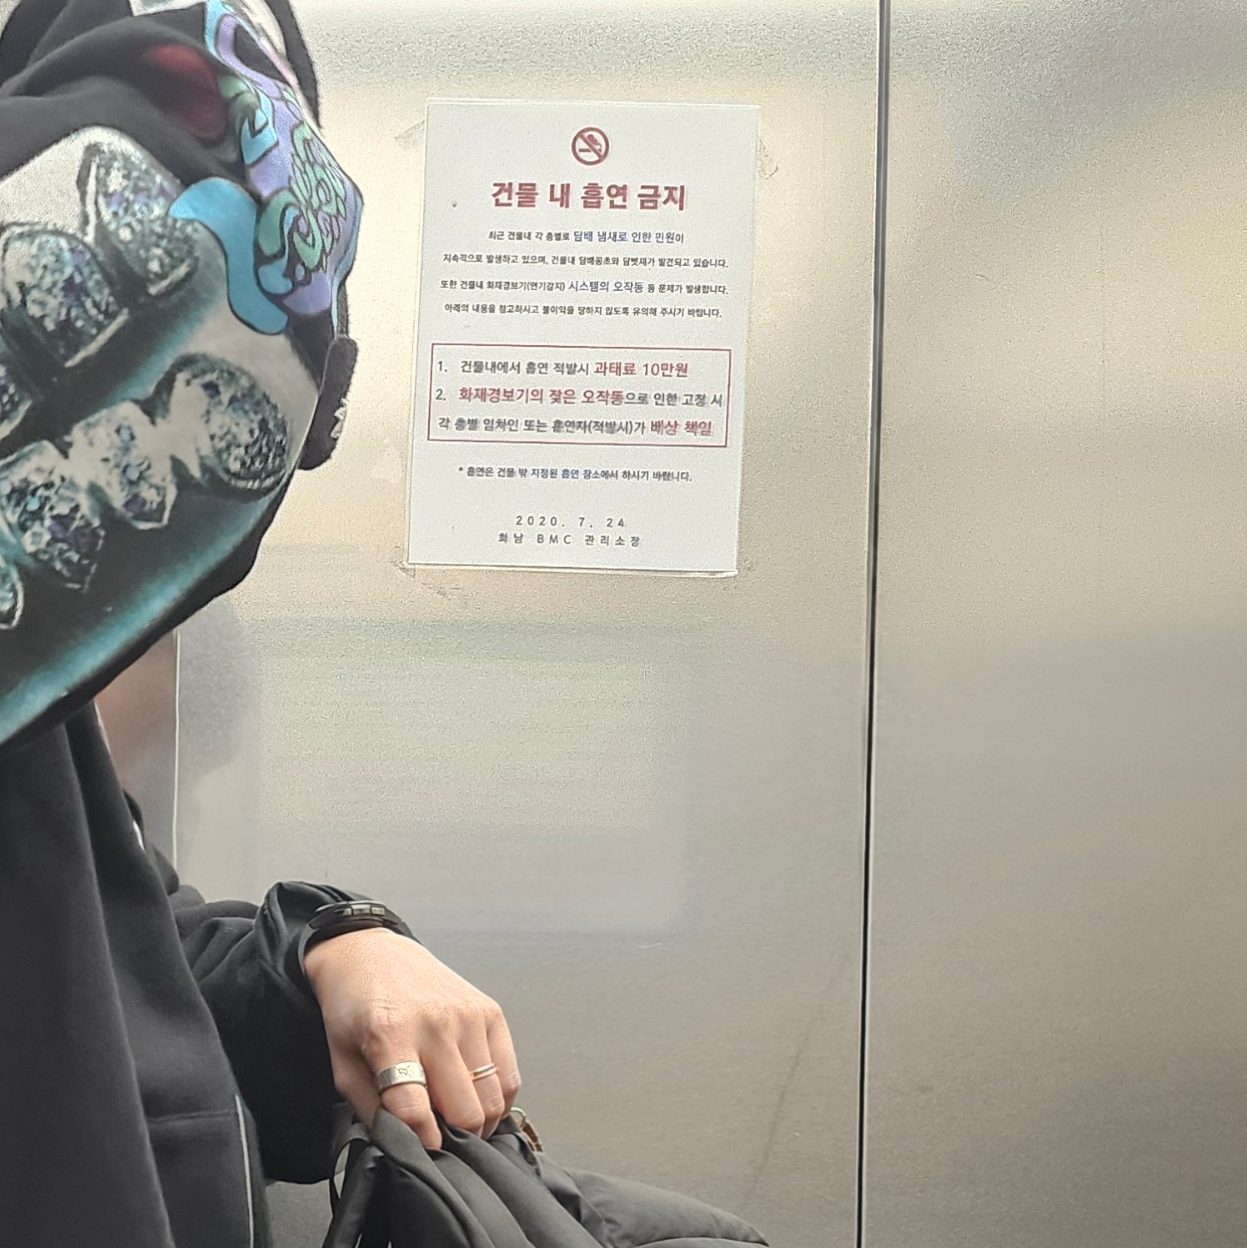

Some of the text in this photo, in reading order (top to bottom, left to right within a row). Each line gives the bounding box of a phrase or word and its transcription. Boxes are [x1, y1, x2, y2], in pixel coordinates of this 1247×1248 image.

[491, 182, 686, 211] 건물 내 흡연 금지
[488, 231, 504, 240] 최근
[507, 231, 532, 241] 건물내
[535, 232, 543, 241] 각
[573, 231, 593, 242] 담배
[597, 232, 627, 243] 냄새로
[631, 232, 652, 243] 인한
[655, 233, 684, 244] 민원이
[443, 254, 482, 263] 지속적으로
[486, 254, 519, 264] 발생하고
[551, 256, 575, 265] 건물내
[658, 258, 690, 267] 발견되고
[693, 258, 729, 268] 있습니다.
[440, 280, 457, 289] 또한
[460, 280, 484, 290] 건물내
[568, 281, 609, 292] 시스템의
[613, 282, 644, 294] 오작동
[658, 284, 683, 294] 문제가
[686, 284, 729, 295] 발생합니다.
[444, 304, 469, 313] 아래의
[472, 304, 495, 314] 내용을
[577, 306, 602, 315] 당하지
[633, 307, 657, 317] 유의해
[660, 307, 685, 317] 주시기
[687, 308, 722, 318] 바랍니다.
[437, 361, 688, 377] 1. 건물내에서 흡연 적발시 과태료 10만원
[436, 389, 446, 401] 2.
[459, 387, 544, 404] 화재경보기의
[549, 388, 575, 404] 잦은
[581, 389, 648, 405] 오작동으로
[653, 393, 677, 406] 인한
[710, 394, 723, 407] 시
[439, 418, 451, 430] 각
[483, 418, 519, 431] 임차인
[523, 419, 547, 432] 또는
[651, 420, 678, 435] 배상
[684, 420, 713, 436] 책임
[497, 467, 515, 477] 건물
[530, 468, 558, 478] 지정된
[561, 469, 579, 478] 흡연
[583, 469, 618, 480] 장소에서
[622, 470, 649, 480] 하시기
[516, 516, 625, 528] 2020. 7. 24
[537, 534, 571, 545] BMC
[585, 535, 640, 546] 관리소장
